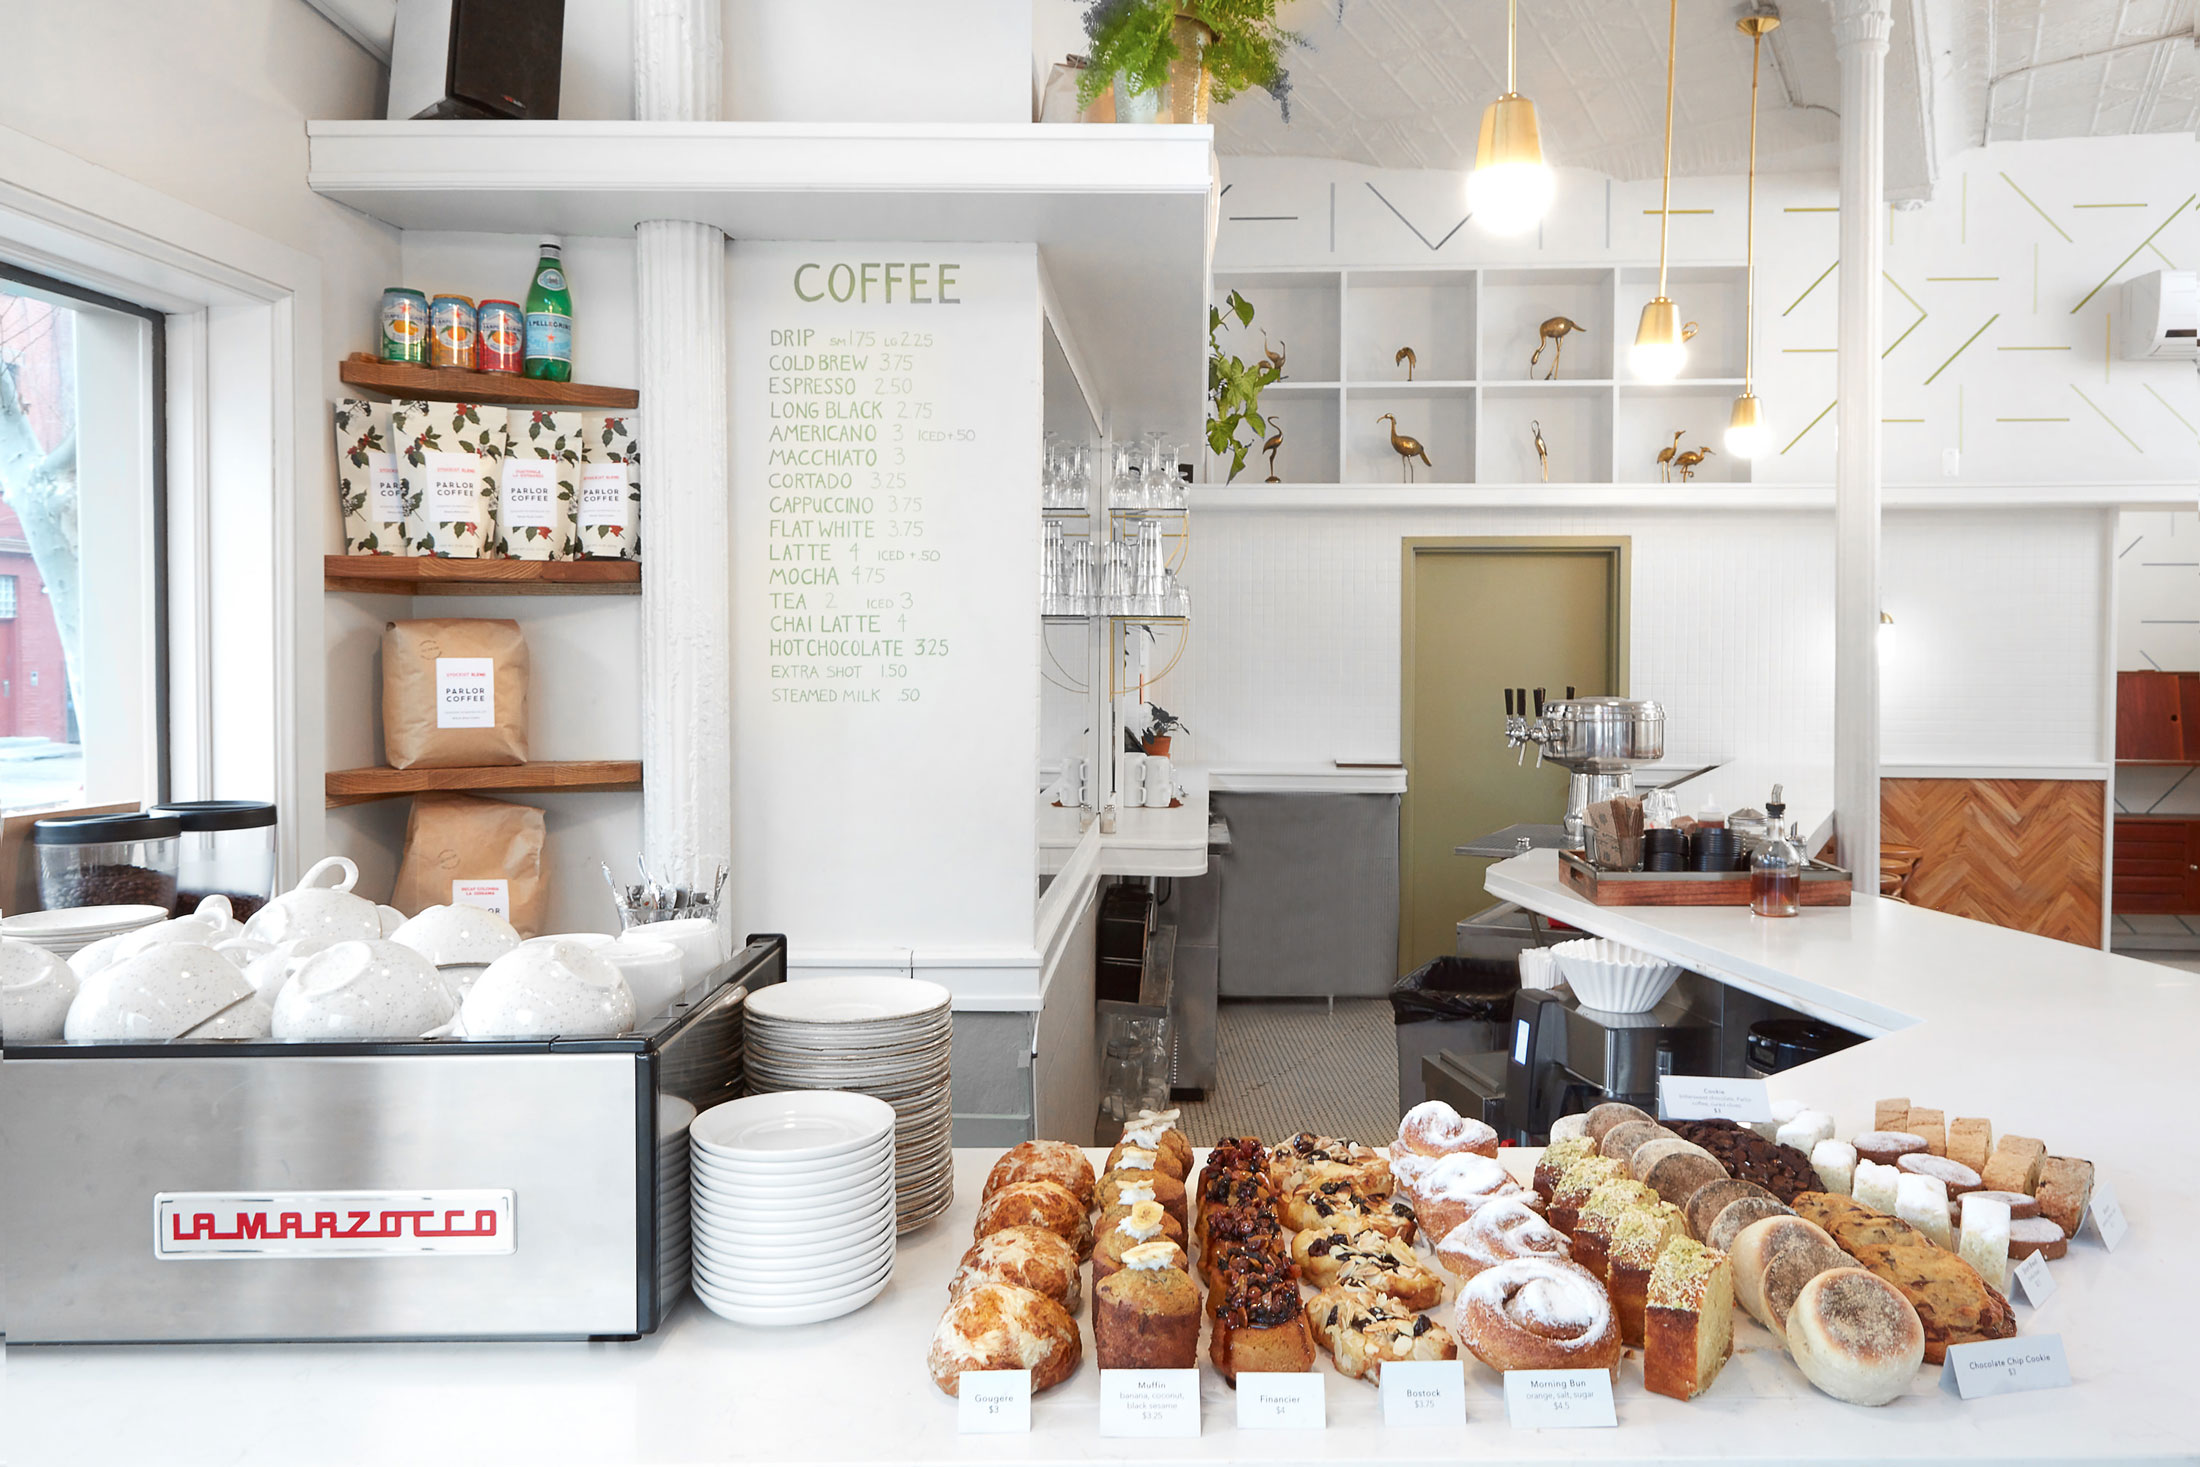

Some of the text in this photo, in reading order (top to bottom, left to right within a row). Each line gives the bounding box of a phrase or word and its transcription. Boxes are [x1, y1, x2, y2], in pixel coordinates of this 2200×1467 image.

[794, 263, 961, 304] COFFEE
[770, 329, 815, 347] DRIP
[769, 355, 814, 372] COLD
[818, 355, 868, 372] BREW
[769, 377, 856, 395] ESPRESSO
[770, 402, 819, 419] LONG
[826, 401, 883, 419] BLACK
[769, 424, 877, 443] AMERICANO
[893, 424, 904, 442] 3
[769, 448, 906, 467] MACCHIATO 3
[769, 472, 852, 490] CORTADO
[769, 496, 874, 514] CAPPUCCINO
[769, 520, 814, 538] FLAT
[818, 520, 875, 538] WHITE
[769, 543, 832, 561] LATTE
[848, 542, 861, 562] 4
[877, 549, 905, 562] ICED
[769, 567, 839, 585] MOCHA
[769, 592, 914, 610] TEA 2 ICED 3
[770, 614, 908, 633] CHAI LATTE 4
[770, 639, 805, 657] HOT
[807, 639, 903, 657] CHOCOLATE
[771, 665, 819, 679] EXTRA
[826, 665, 862, 679] SHOT
[771, 688, 838, 703] STEAMED
[843, 688, 880, 703] MILK
[1969, 1354, 2051, 1370] Chocolate Chip Cookie
[1138, 1381, 1166, 1389] Muffin
[1530, 1379, 1586, 1389] Morning Bun
[1119, 1391, 1185, 1400] banana, coconut,
[1260, 1394, 1300, 1403] Financier
[1406, 1389, 1440, 1398] Bostock
[1526, 1391, 1594, 1401] orange, salt, sugar
[989, 1405, 999, 1414] $3
